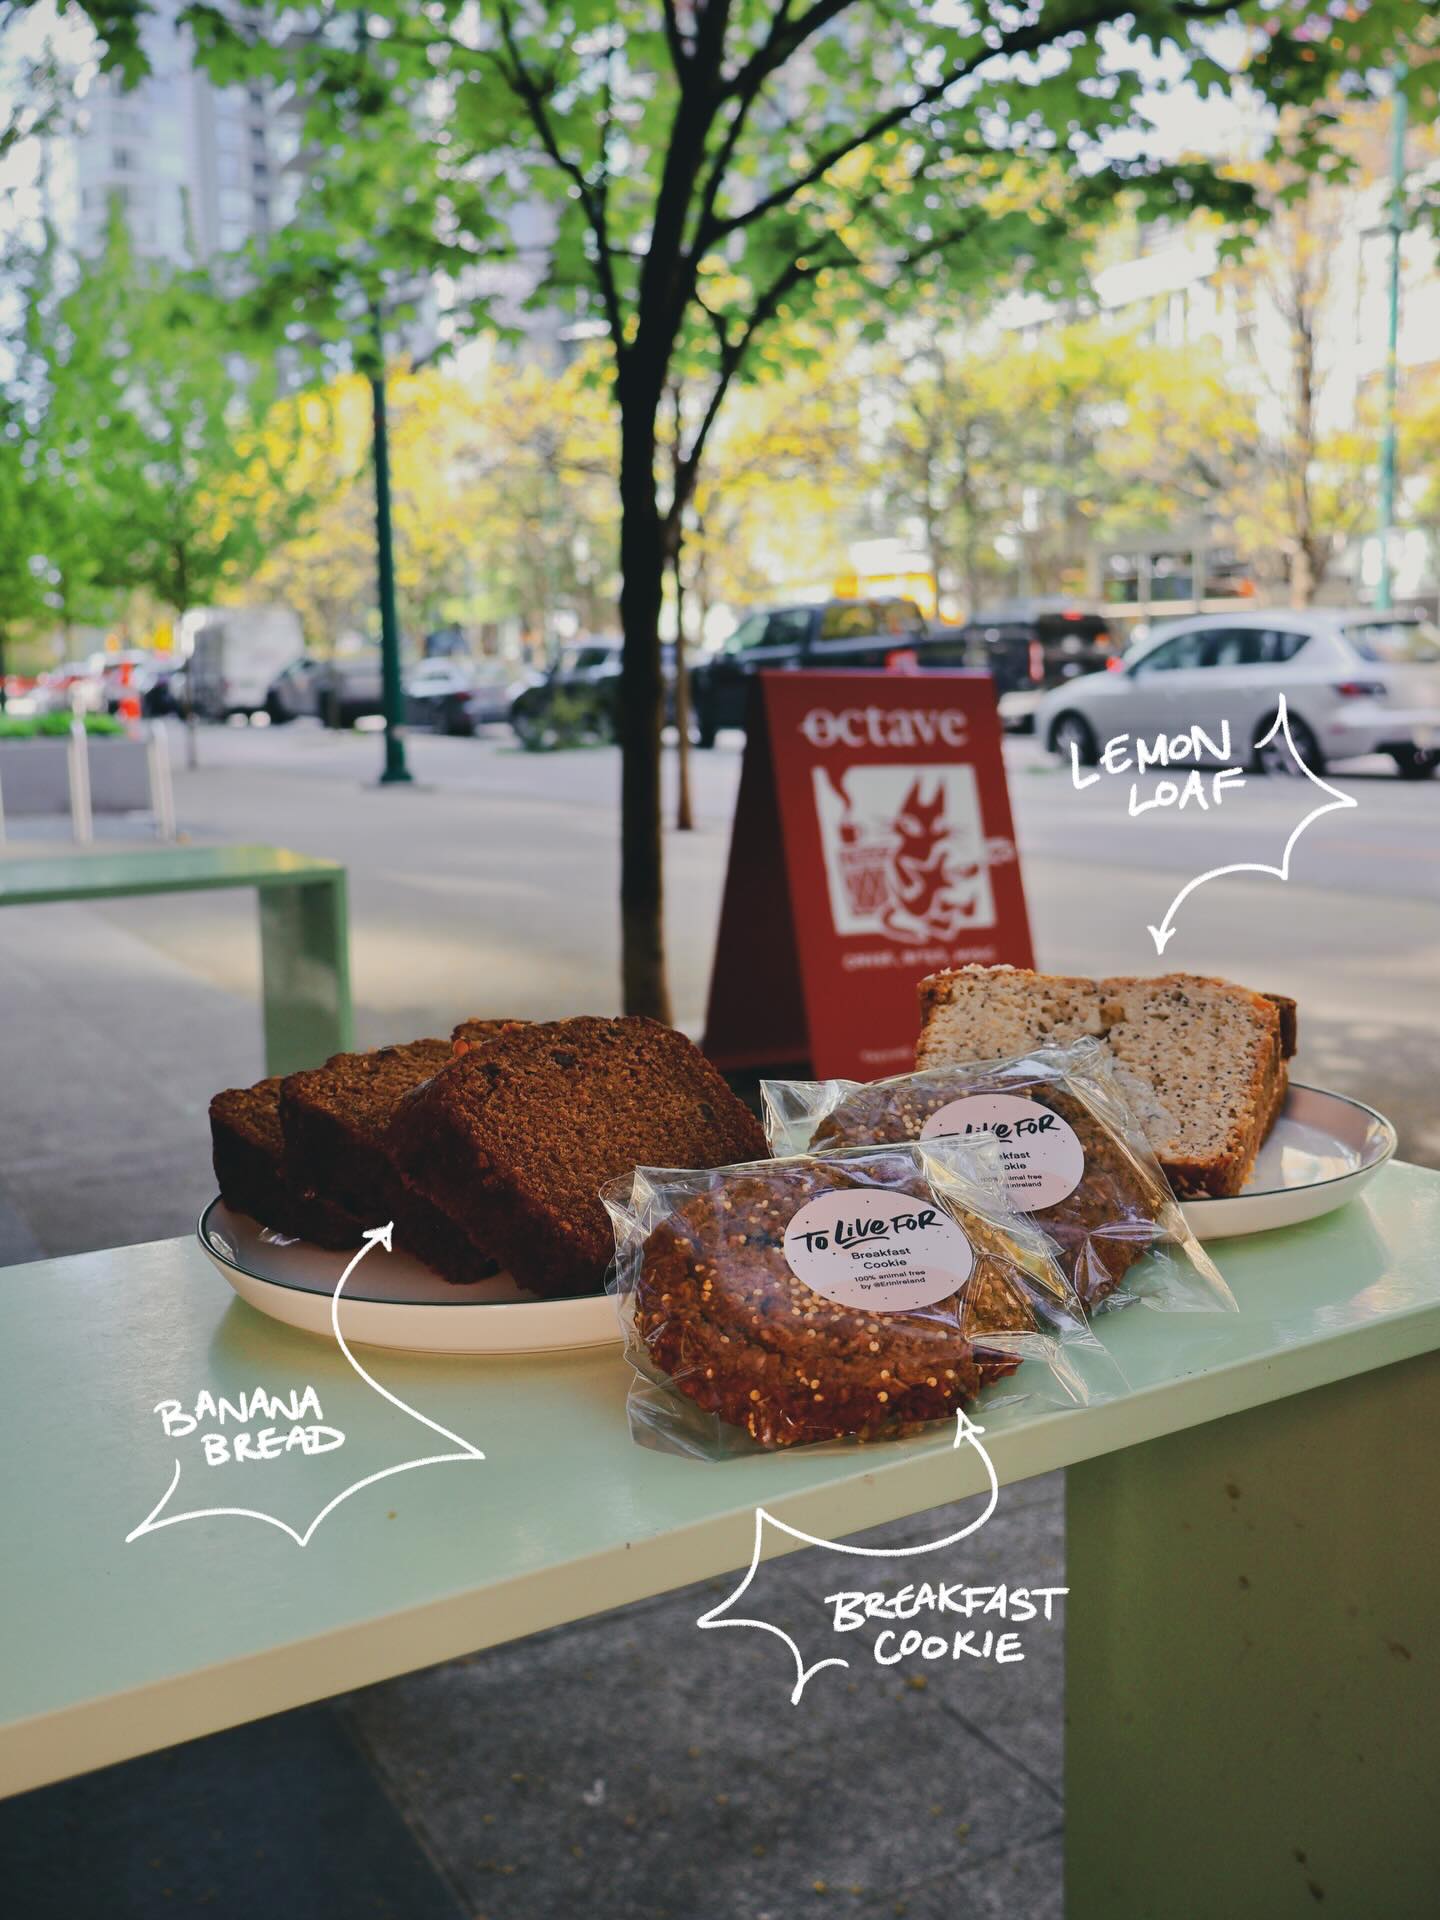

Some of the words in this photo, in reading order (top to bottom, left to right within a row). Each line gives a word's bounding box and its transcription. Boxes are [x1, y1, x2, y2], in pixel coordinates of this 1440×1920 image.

[802, 705, 969, 748] octave
[851, 1247, 912, 1260] Breakfast
[863, 1259, 907, 1270] Cookie
[854, 1274, 877, 1282] 100%
[878, 1271, 907, 1279] animal
